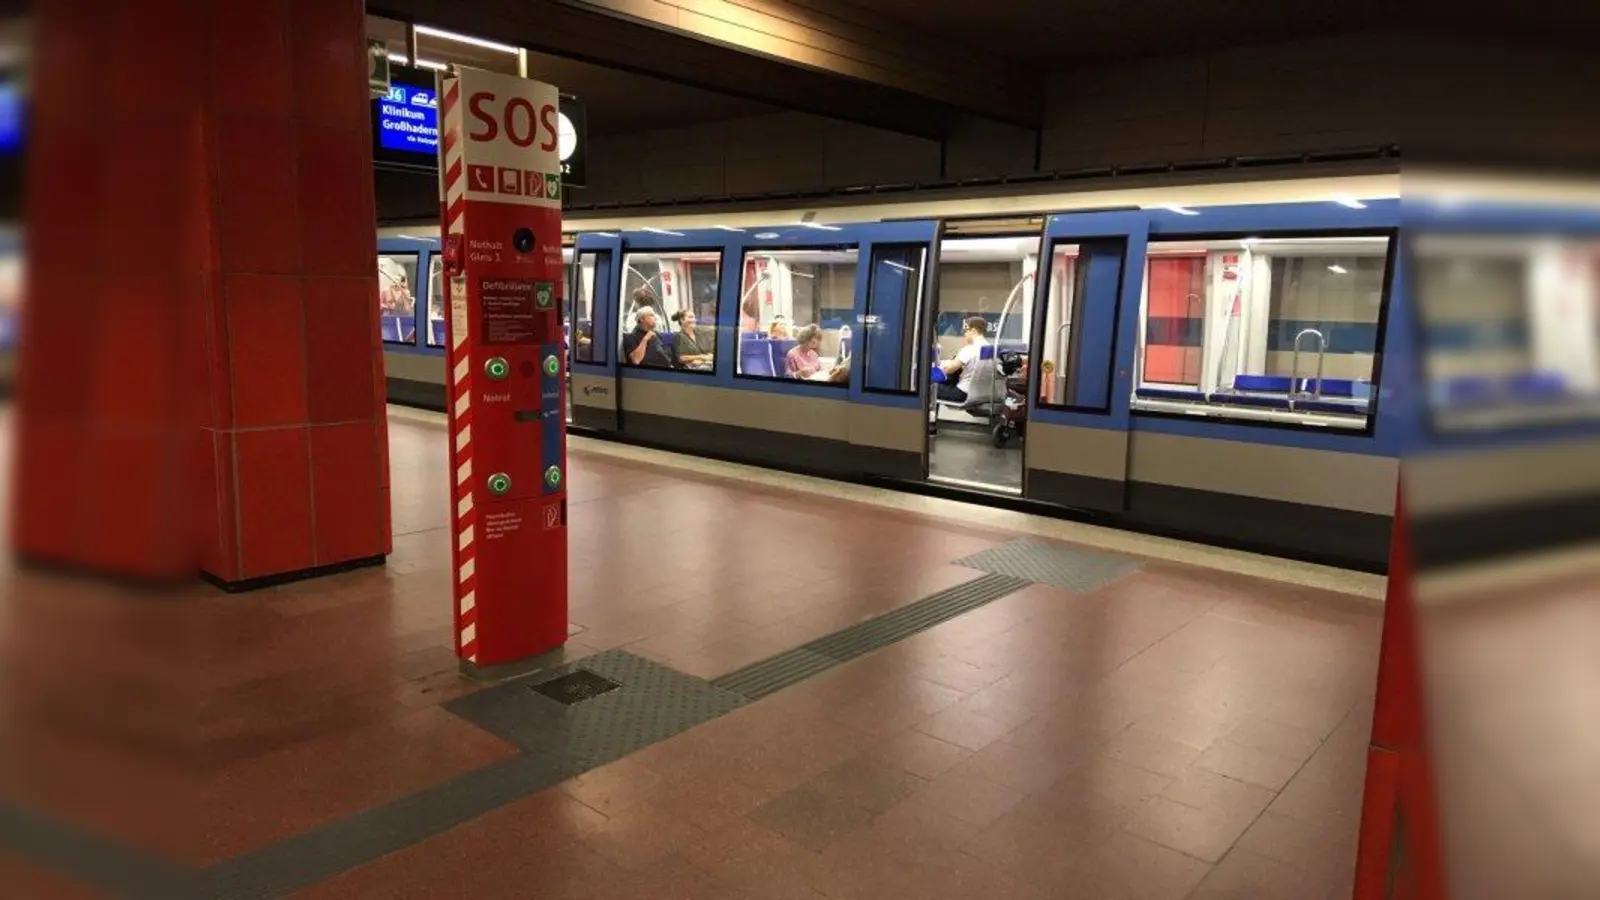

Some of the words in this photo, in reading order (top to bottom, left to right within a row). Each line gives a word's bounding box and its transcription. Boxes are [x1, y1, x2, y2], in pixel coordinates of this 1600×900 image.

[382, 104, 425, 121] Klinikum
[382, 119, 438, 136] Großhadern
[468, 91, 558, 153] SOS
[565, 163, 571, 174] 2
